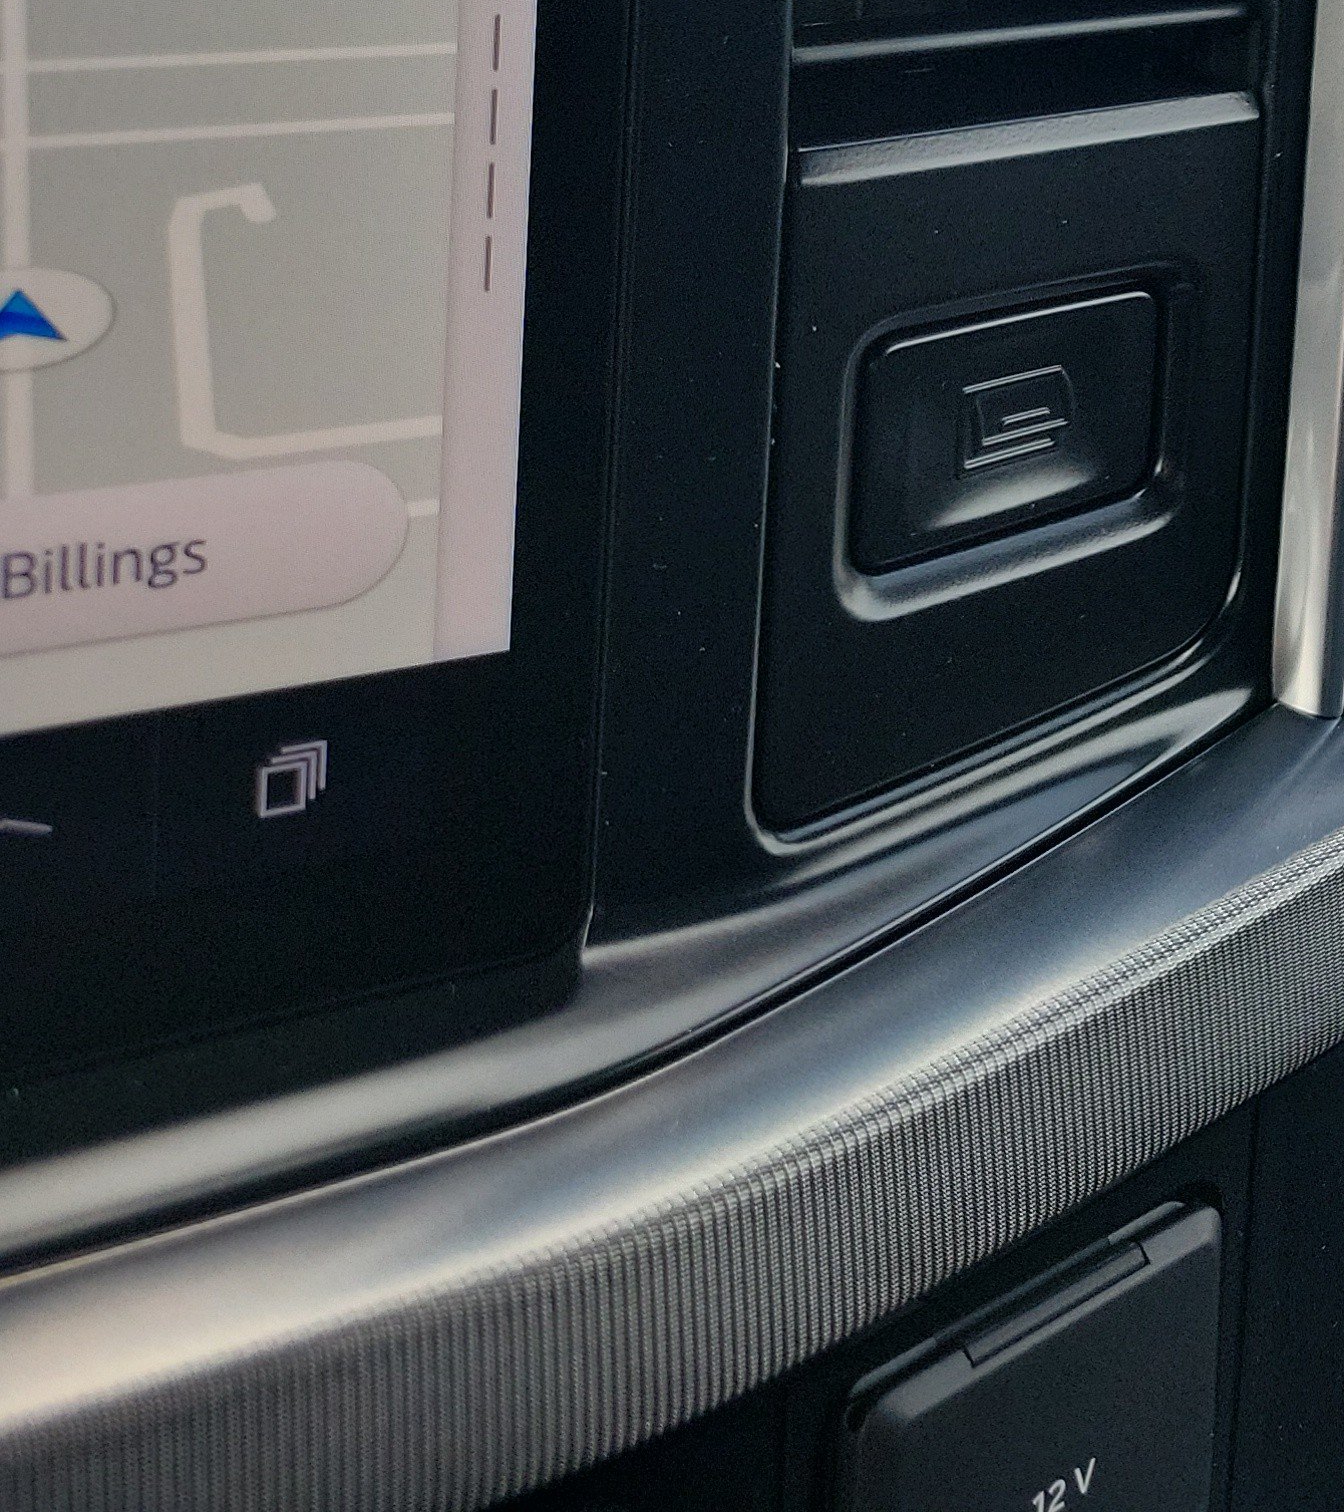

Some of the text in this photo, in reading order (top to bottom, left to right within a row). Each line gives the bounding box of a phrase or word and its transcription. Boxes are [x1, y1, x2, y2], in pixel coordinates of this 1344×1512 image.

[1, 536, 208, 600] Billings
[1032, 1457, 1096, 1512] 12 V
